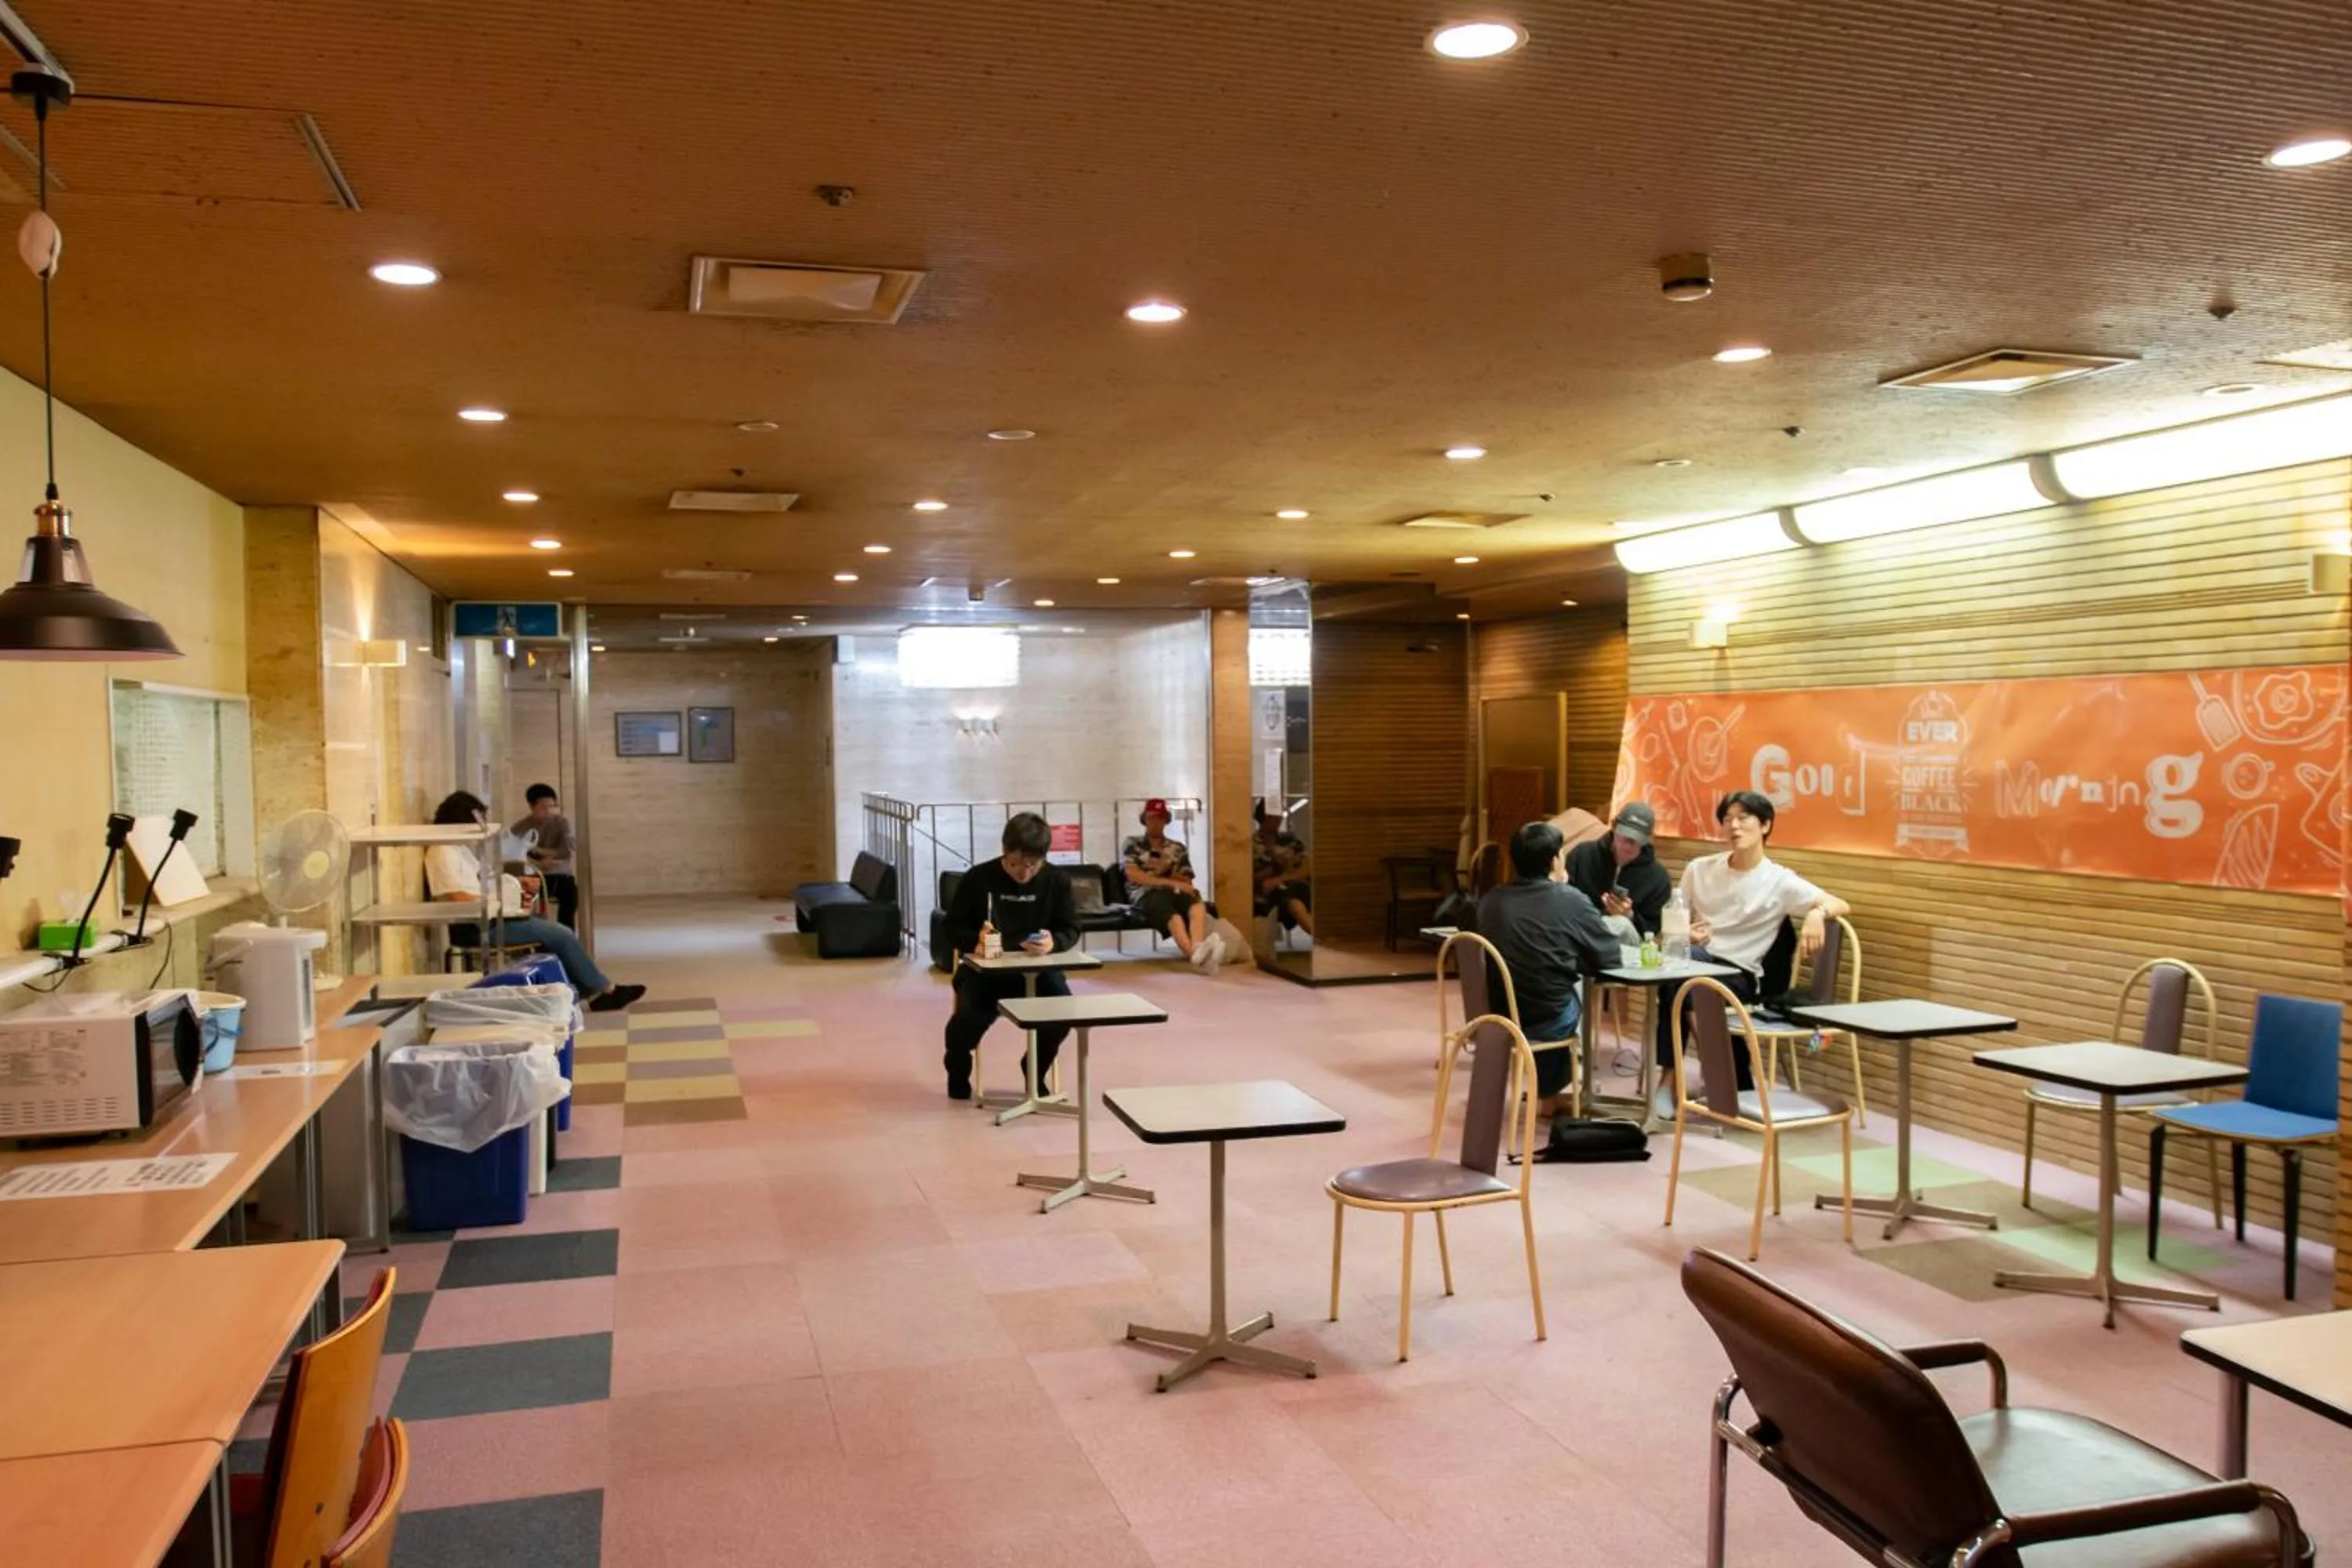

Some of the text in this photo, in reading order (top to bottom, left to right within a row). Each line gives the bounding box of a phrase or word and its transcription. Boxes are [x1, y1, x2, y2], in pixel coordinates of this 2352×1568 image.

[1907, 720, 1958, 742] EVER
[1901, 767, 1956, 787] COFFEE
[1901, 792, 1962, 812] BLACK
[1994, 751, 2204, 839] Morning
